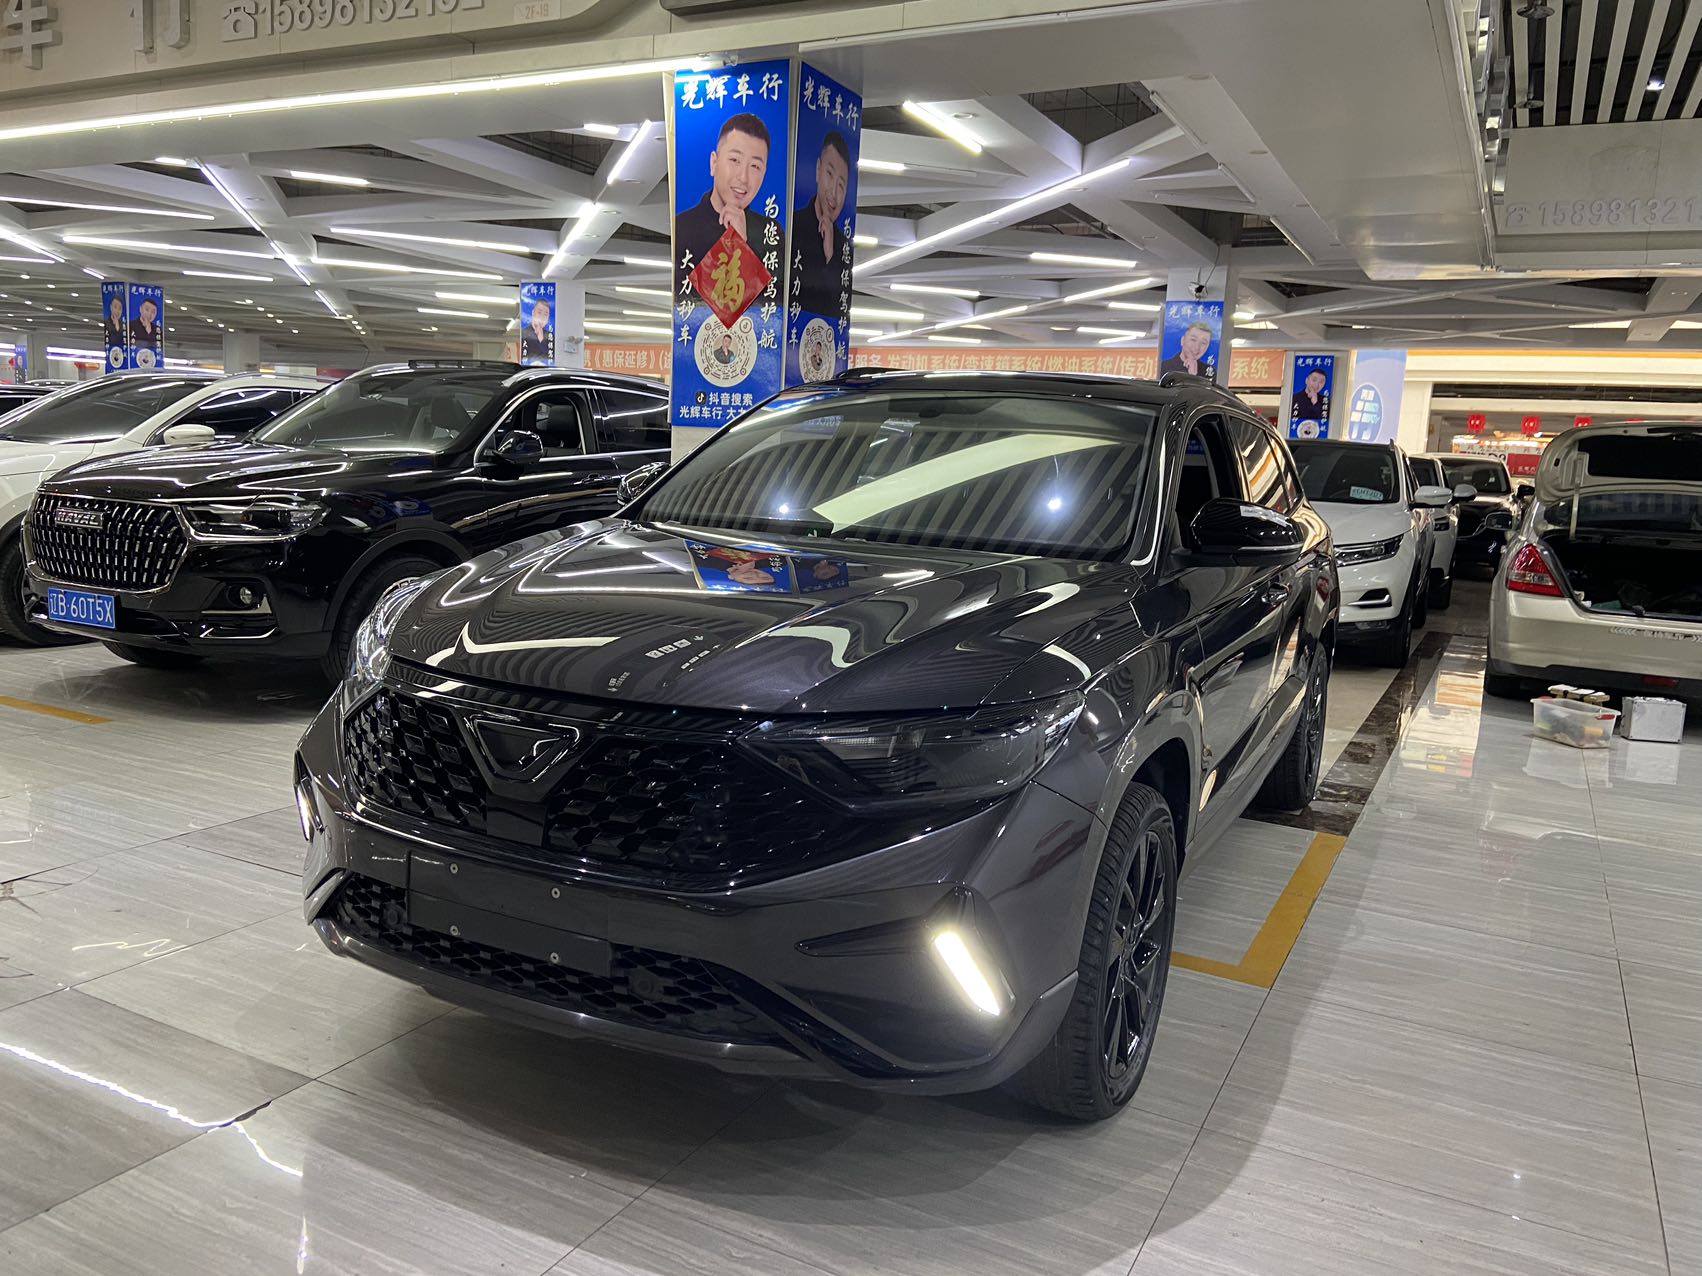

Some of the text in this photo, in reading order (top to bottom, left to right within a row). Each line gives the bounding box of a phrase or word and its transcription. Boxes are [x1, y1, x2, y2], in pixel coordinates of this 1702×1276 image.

[258, 0, 483, 36] 1589813
[681, 73, 783, 110] 光辉车行
[803, 76, 859, 131] 光辉车行
[711, 249, 745, 313] 福
[758, 195, 779, 350] 为您保驾护航
[836, 217, 852, 360] 为您保驾护航
[677, 249, 695, 348] 大力秒车
[789, 249, 803, 350] 大力秒车
[1168, 304, 1220, 319] 光辉车行
[888, 354, 1157, 379] 发动机系统/变速箱系统/燃油系统/传动
[1205, 354, 1214, 381] 为您
[680, 405, 722, 420] 光辉车行
[709, 392, 753, 406] 抖音搜索
[57, 511, 99, 525] HAVAL
[50, 593, 112, 623] 辽B·60T5X
